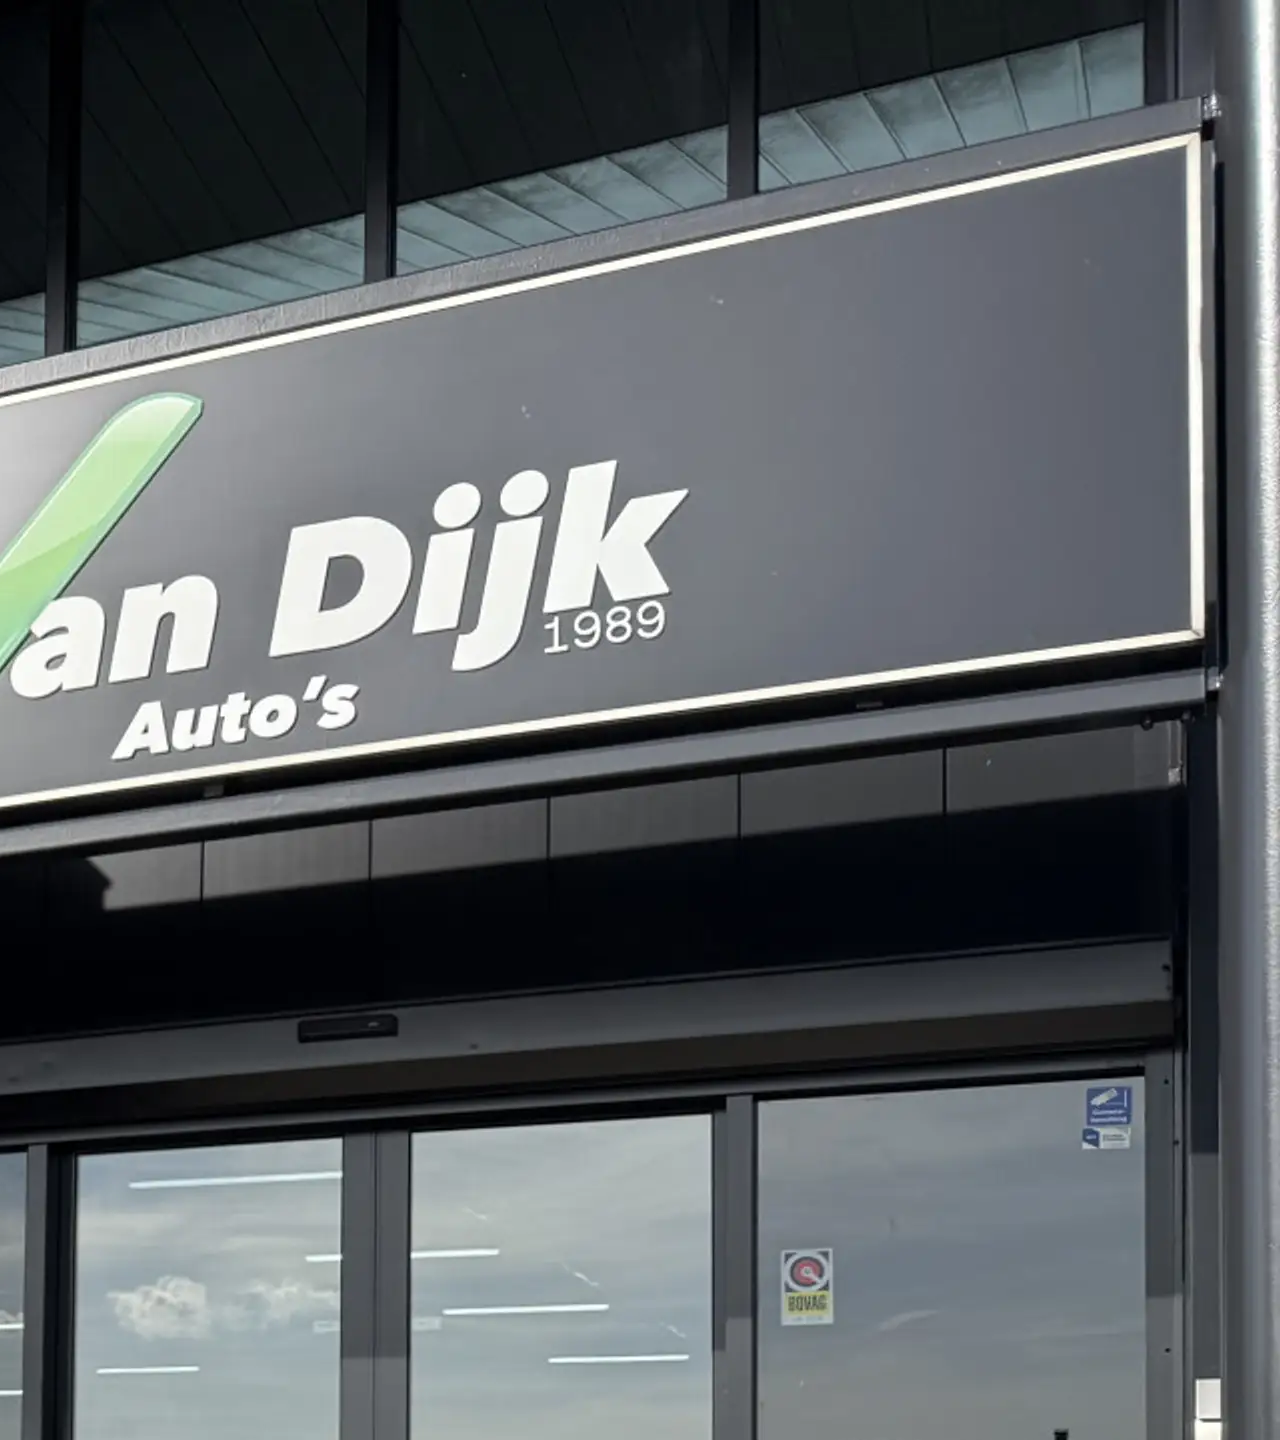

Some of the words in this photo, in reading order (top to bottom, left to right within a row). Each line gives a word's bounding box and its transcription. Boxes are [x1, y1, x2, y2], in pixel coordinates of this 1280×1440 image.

[268, 459, 690, 672] Dijk
[542, 599, 668, 656] 1989
[110, 675, 361, 761] Auto's
[787, 1294, 828, 1312] BOVAG
